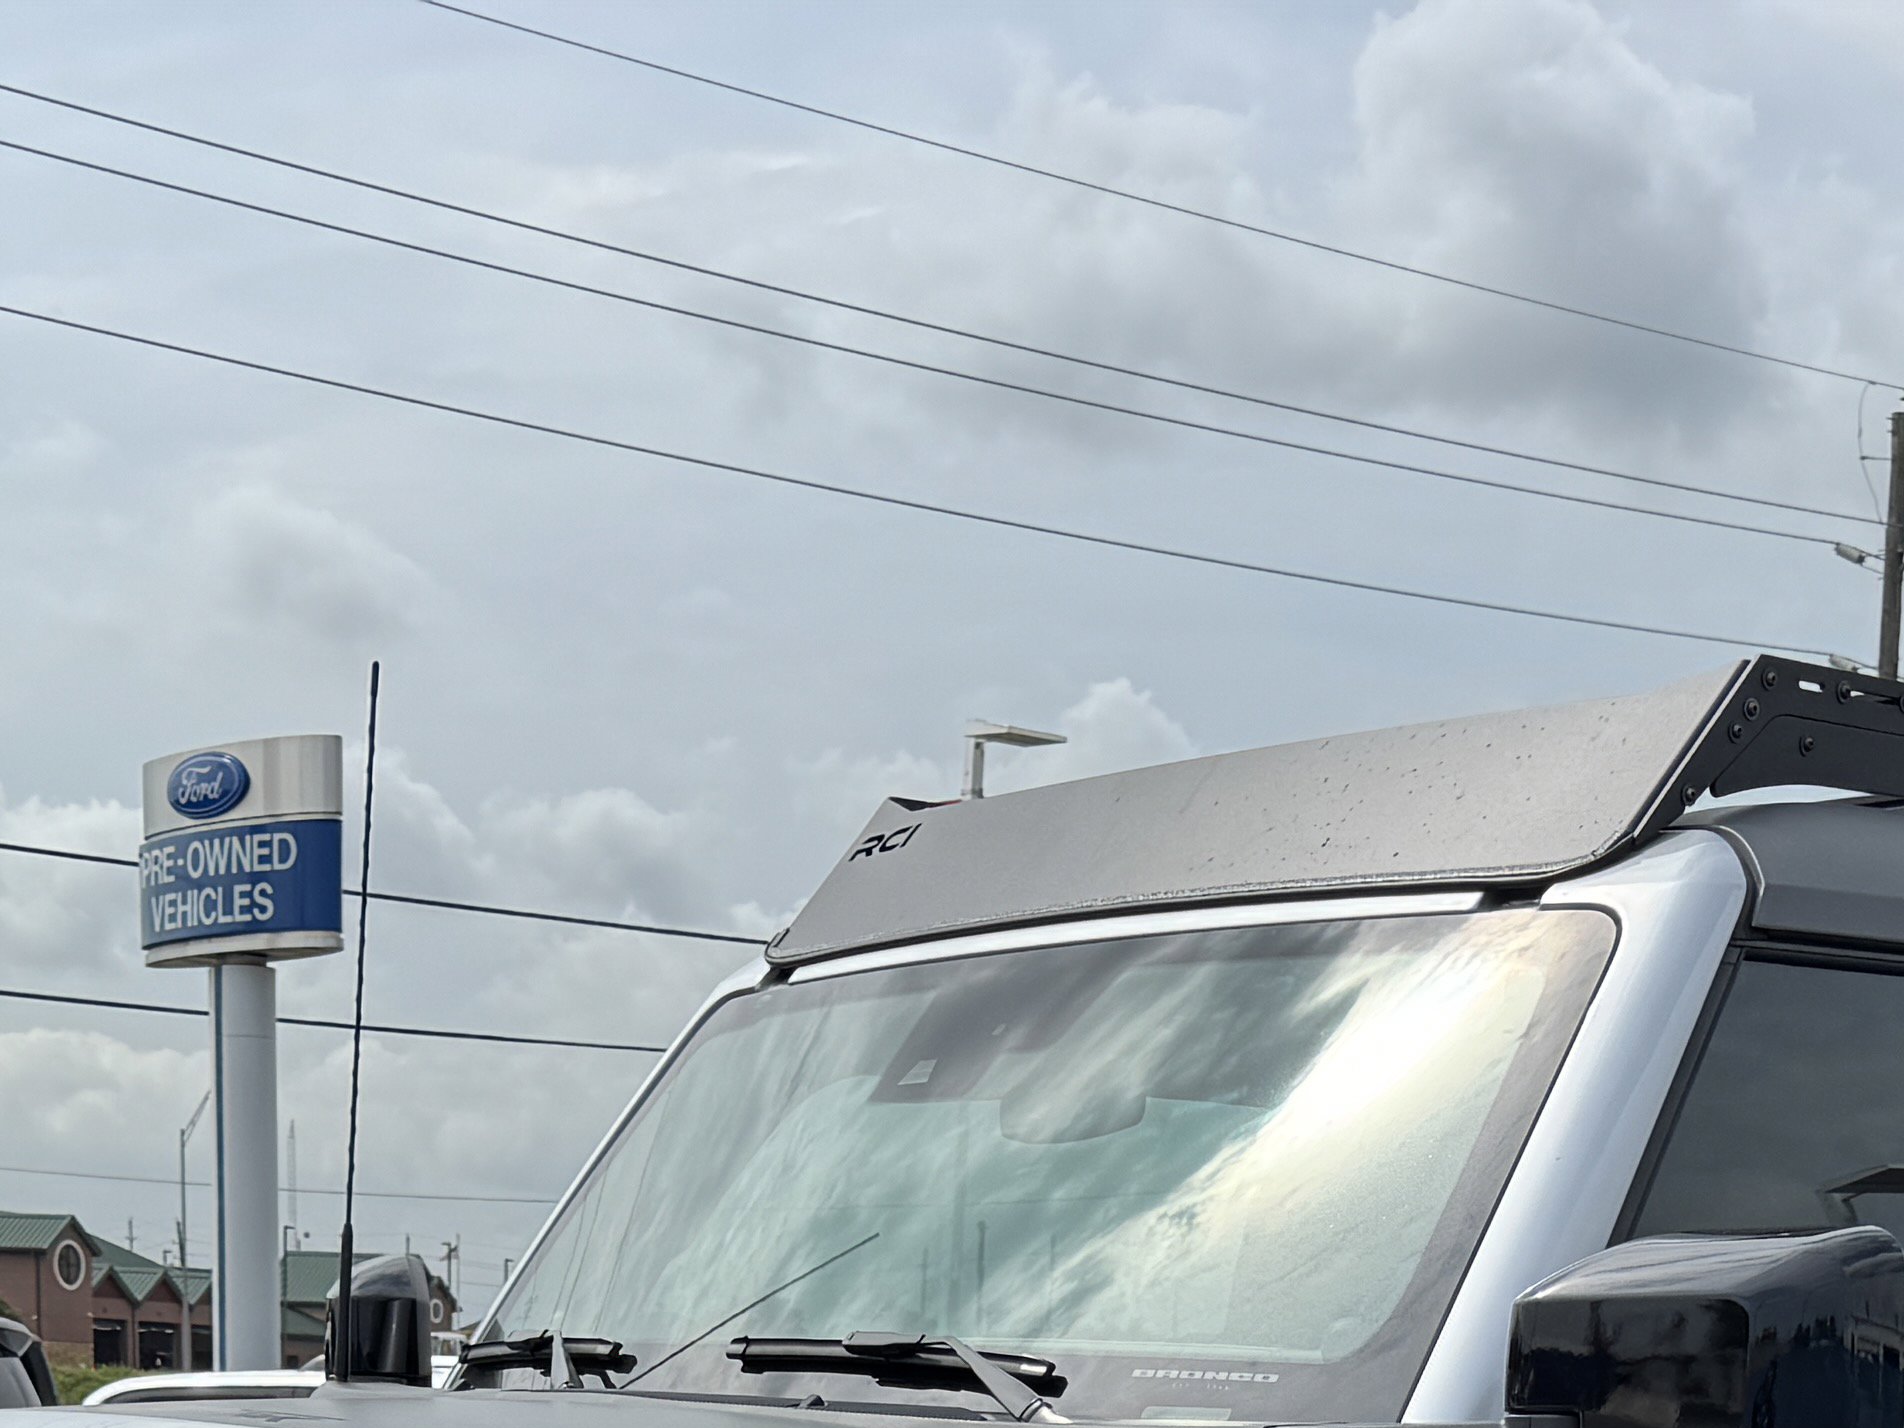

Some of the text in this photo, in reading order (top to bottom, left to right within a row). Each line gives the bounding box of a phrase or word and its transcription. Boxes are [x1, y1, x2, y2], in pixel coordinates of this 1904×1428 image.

[178, 766, 223, 804] Ford
[141, 832, 297, 888] PRE-OWNED
[848, 823, 922, 862] RCI
[151, 882, 274, 932] VEHICLES
